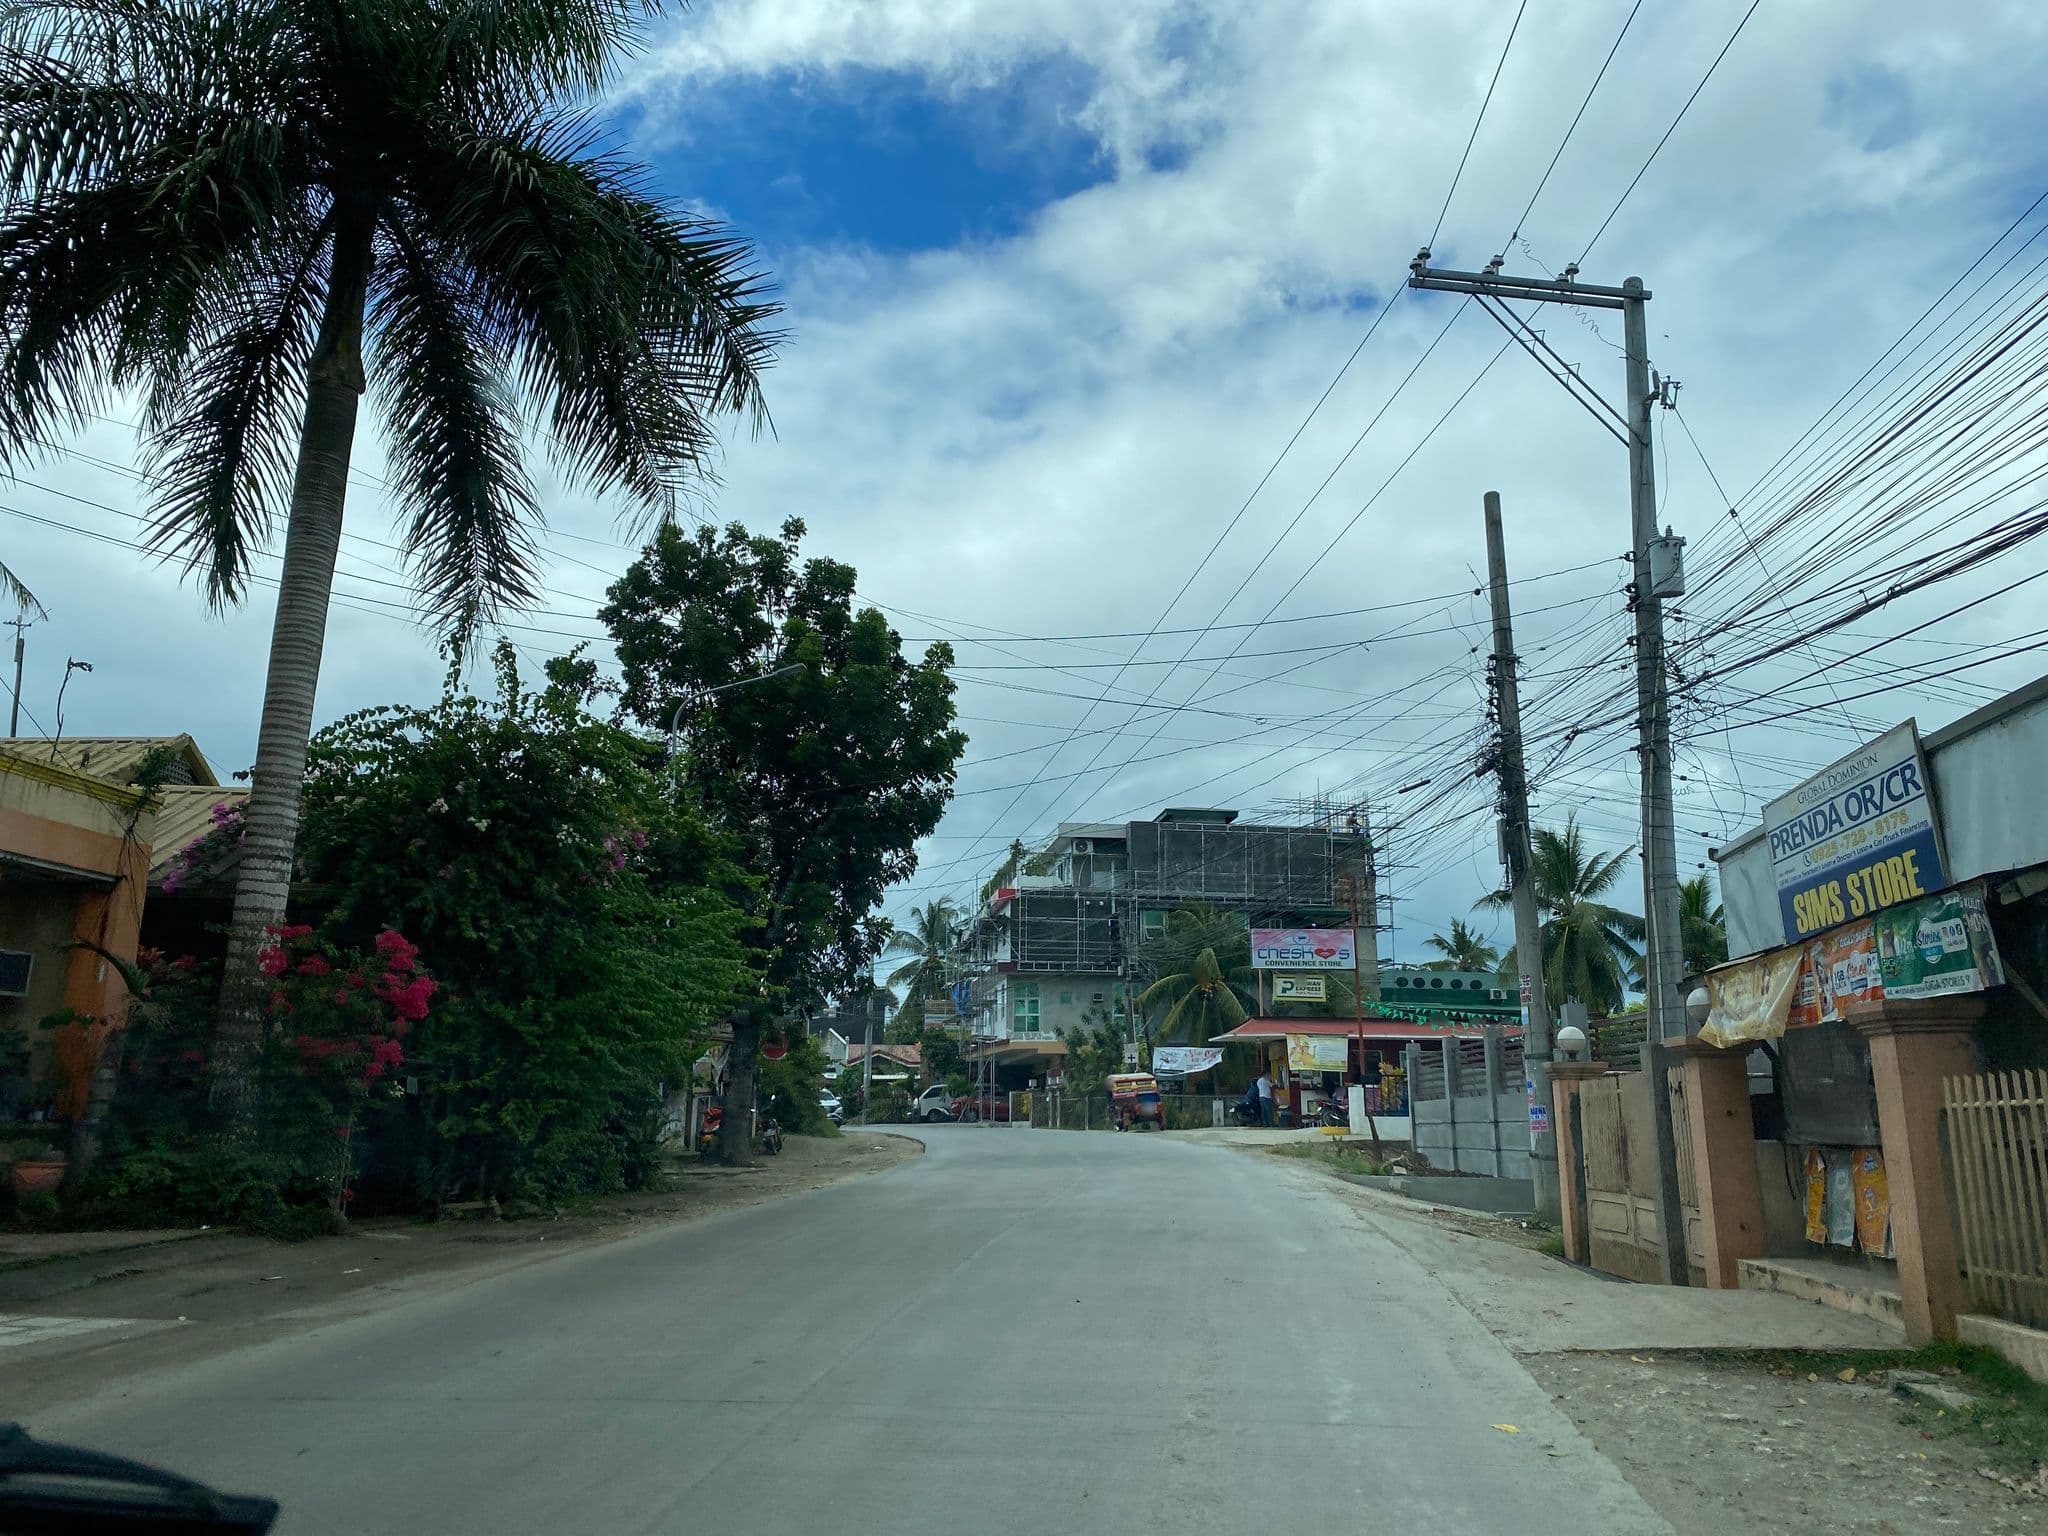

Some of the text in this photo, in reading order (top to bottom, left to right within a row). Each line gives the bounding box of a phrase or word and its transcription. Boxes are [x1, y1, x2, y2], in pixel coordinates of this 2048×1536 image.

[1769, 801, 1844, 859] PRENDA
[1844, 762, 1922, 822] OR/CR
[1797, 781, 1827, 804] GLOBAL
[1828, 753, 1879, 788] DOMINION
[1793, 880, 1845, 934] SIMS
[1846, 849, 1925, 917] STORE
